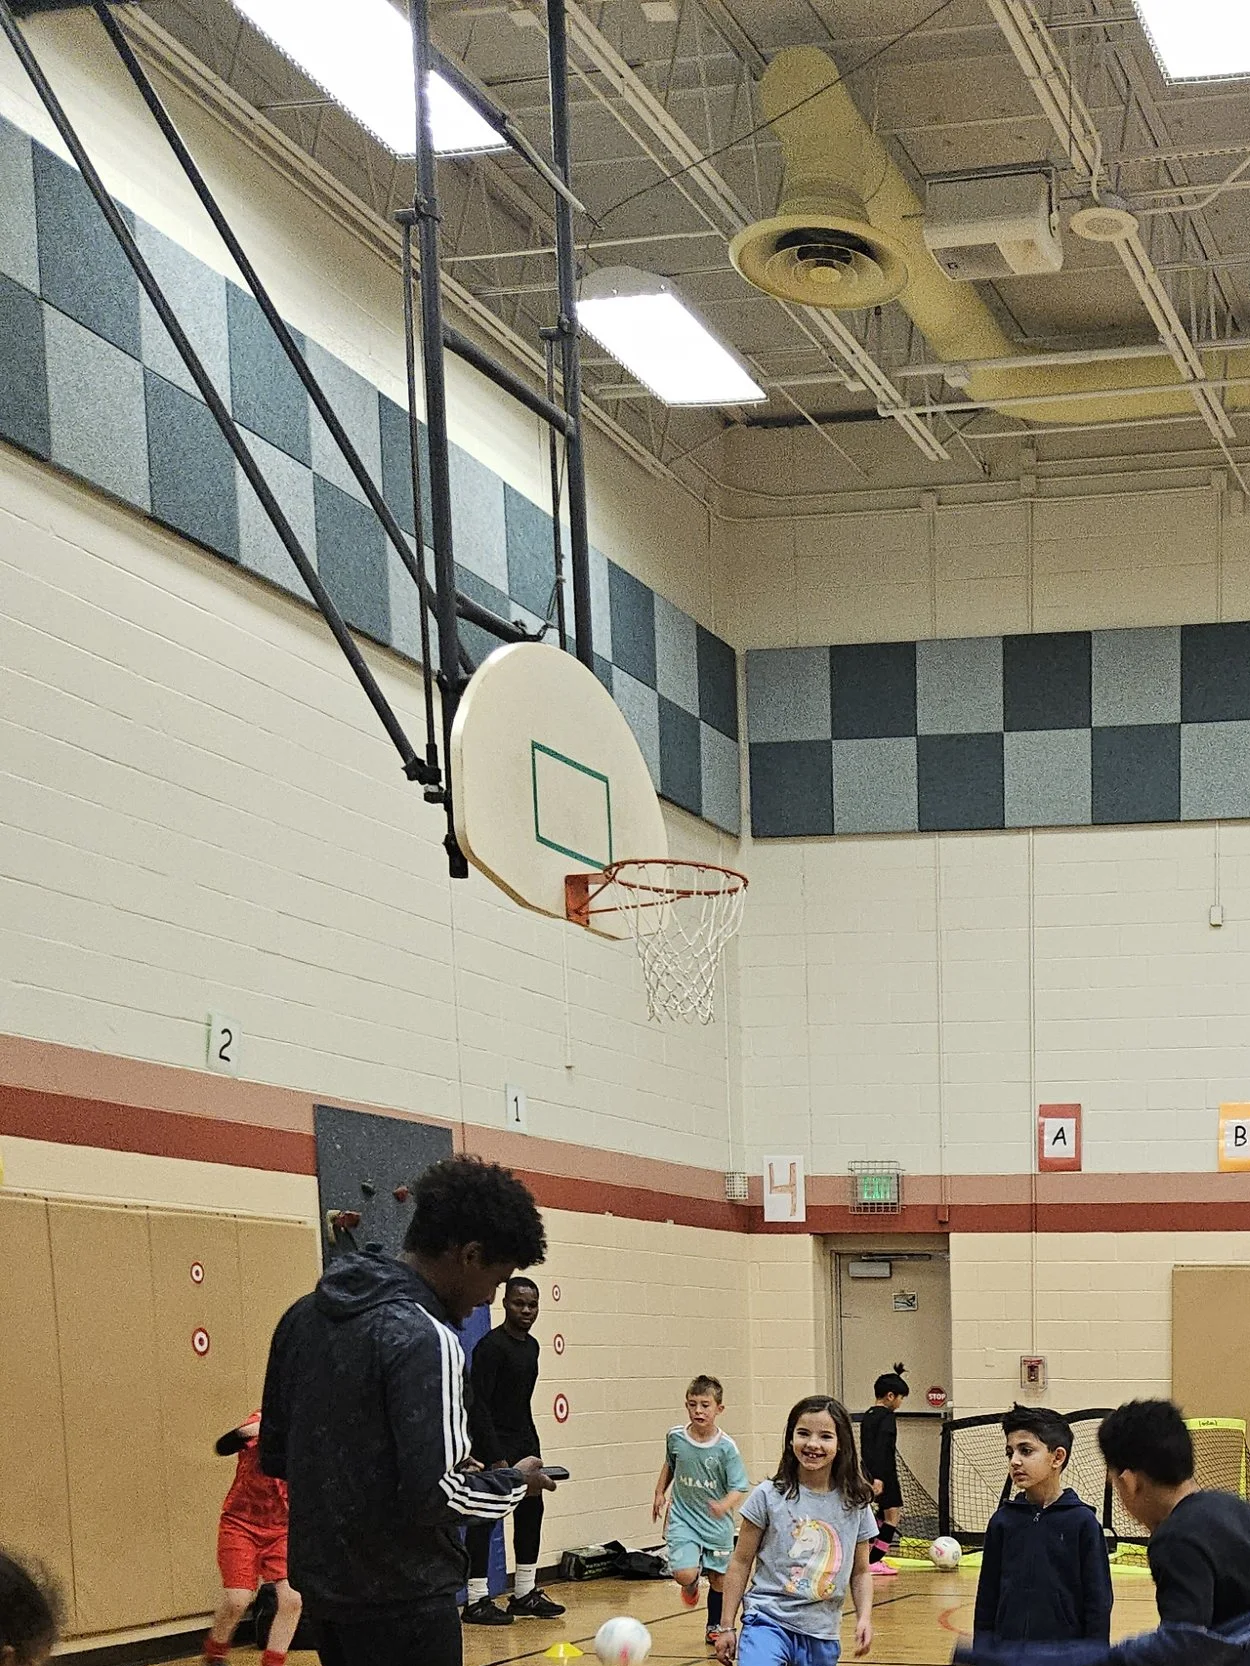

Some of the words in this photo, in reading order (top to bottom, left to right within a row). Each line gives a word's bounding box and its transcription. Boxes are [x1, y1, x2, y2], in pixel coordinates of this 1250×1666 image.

[219, 1028, 233, 1062] 2
[513, 1096, 521, 1122] 1
[1052, 1126, 1067, 1146] A
[1234, 1125, 1247, 1147] B
[768, 1162, 797, 1216] 4
[862, 1176, 893, 1199] EXIT
